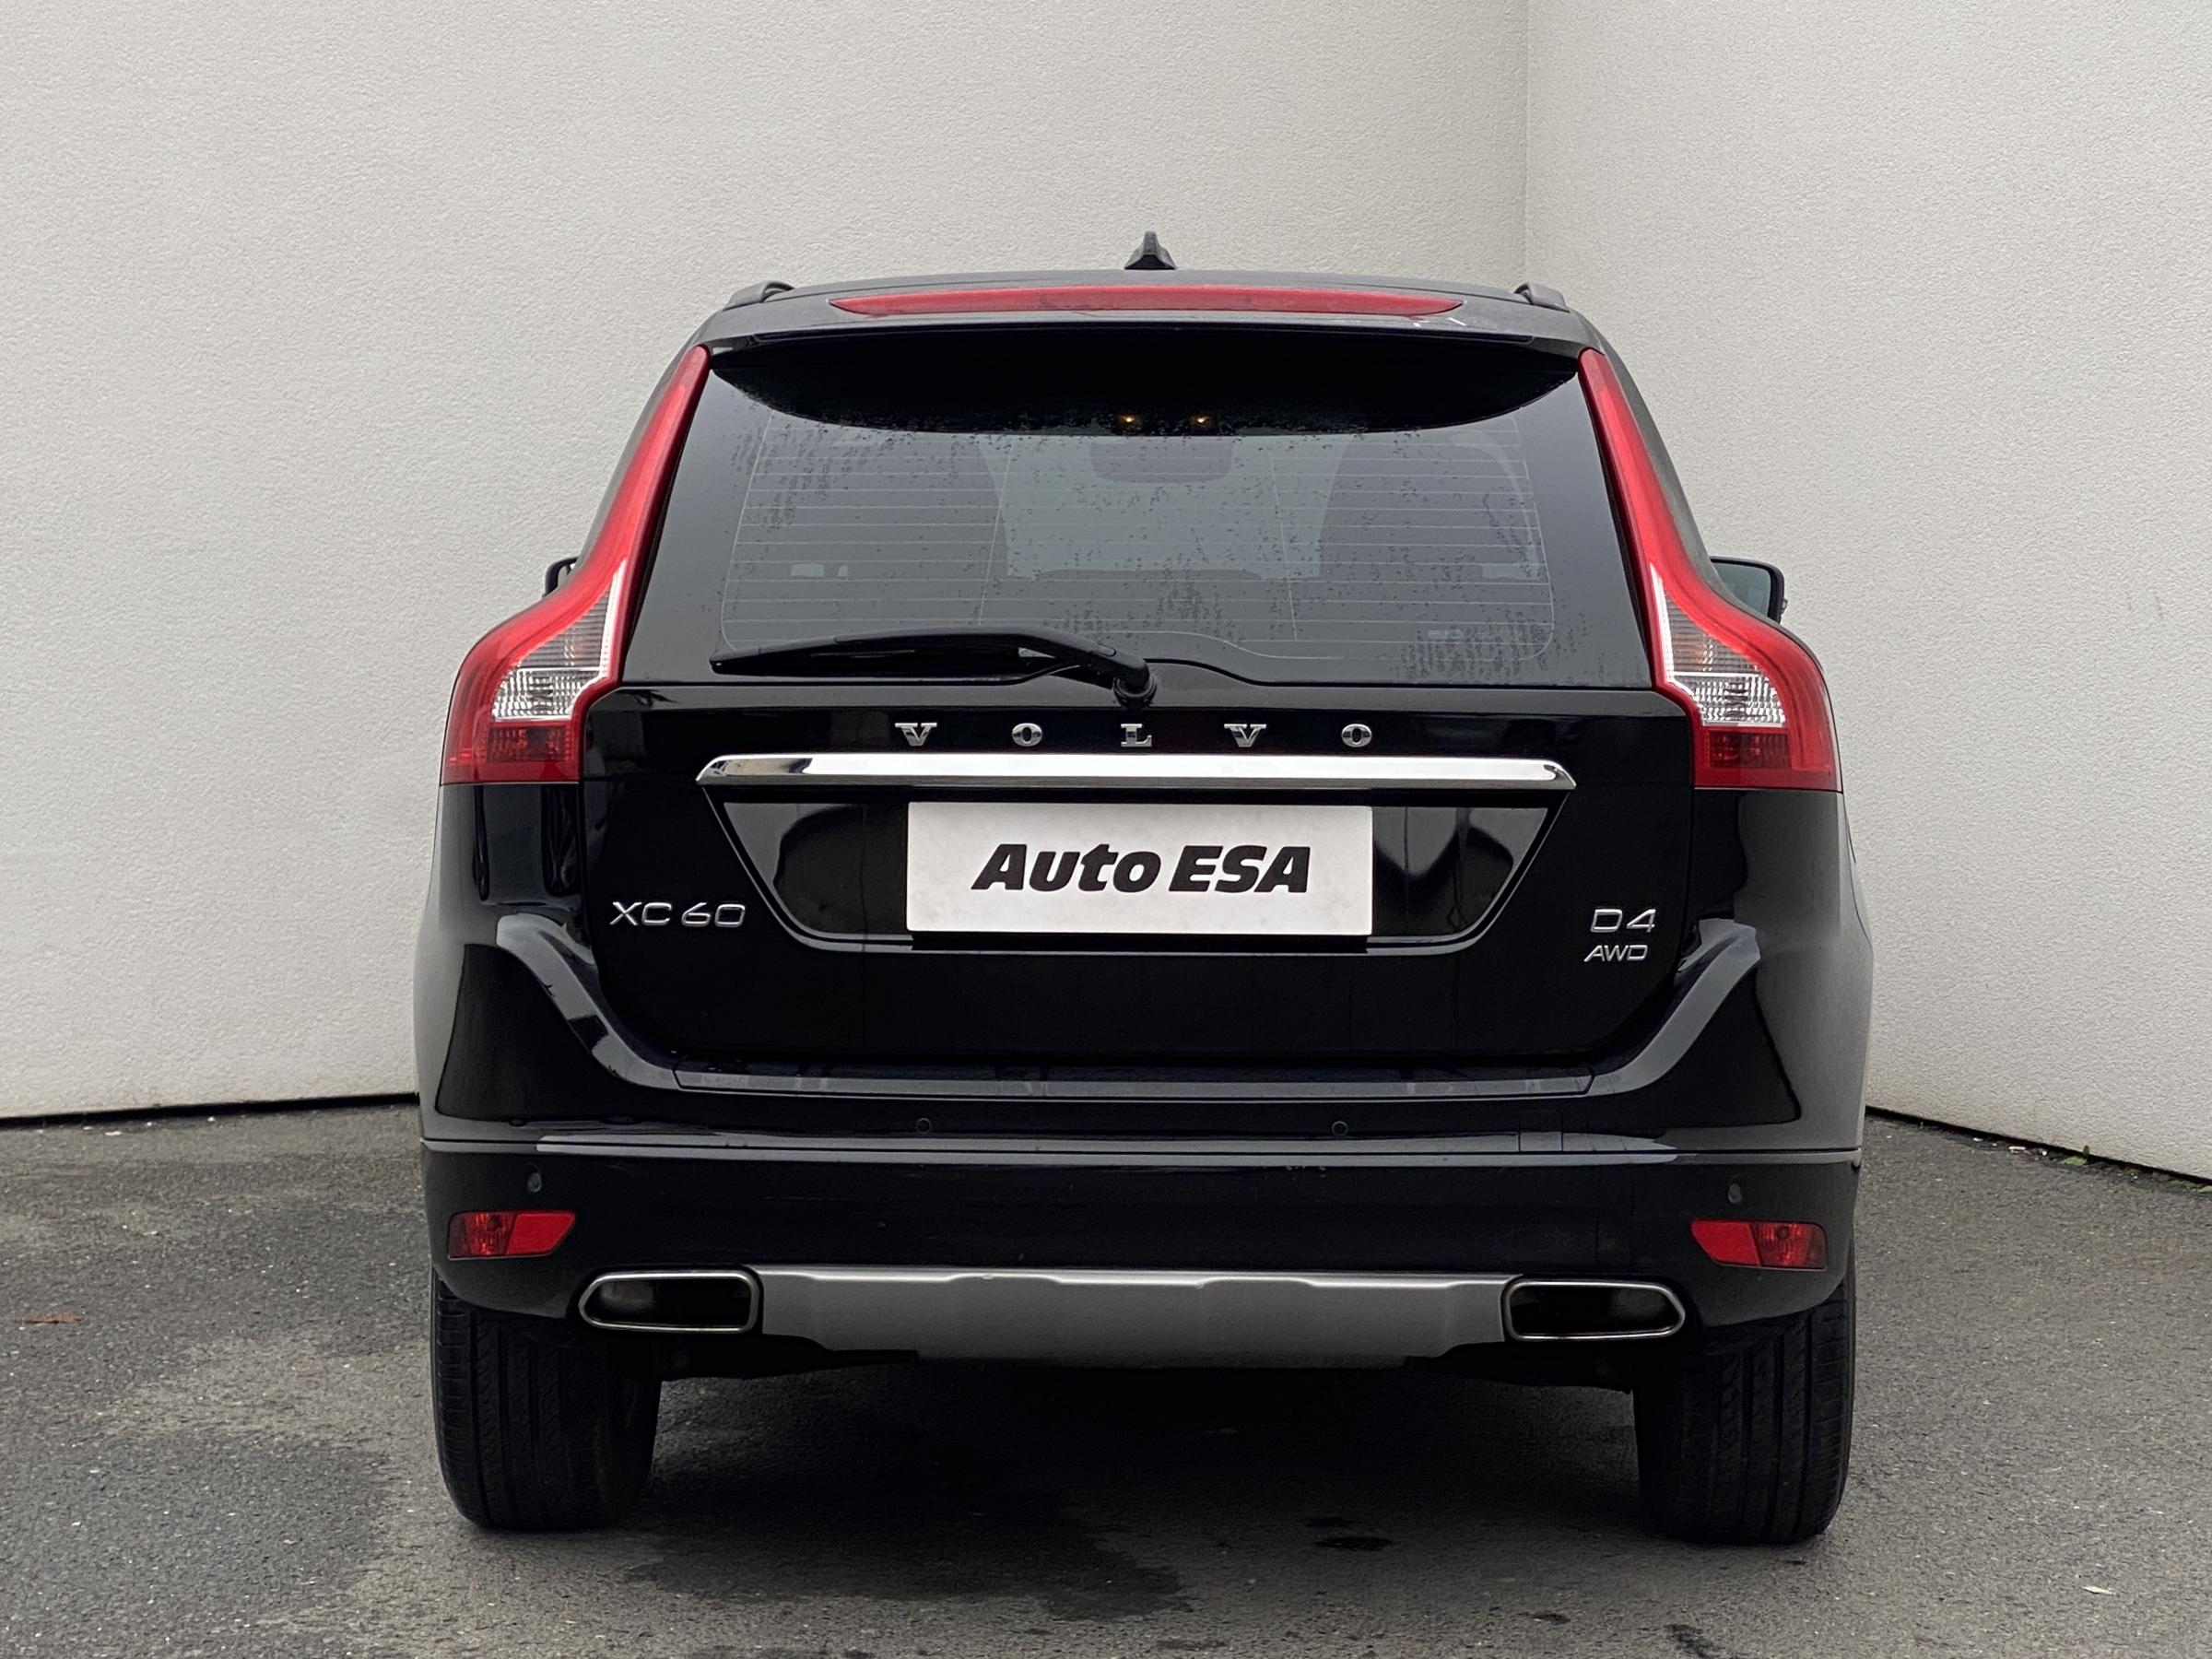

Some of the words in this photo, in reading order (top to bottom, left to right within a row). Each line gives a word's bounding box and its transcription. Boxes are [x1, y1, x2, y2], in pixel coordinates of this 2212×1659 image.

[895, 722, 1372, 748] VOLVO
[971, 843, 1161, 894] Auto
[1169, 845, 1311, 894] ESA
[1590, 909, 1656, 933] D4
[1583, 945, 1648, 962] AWD
